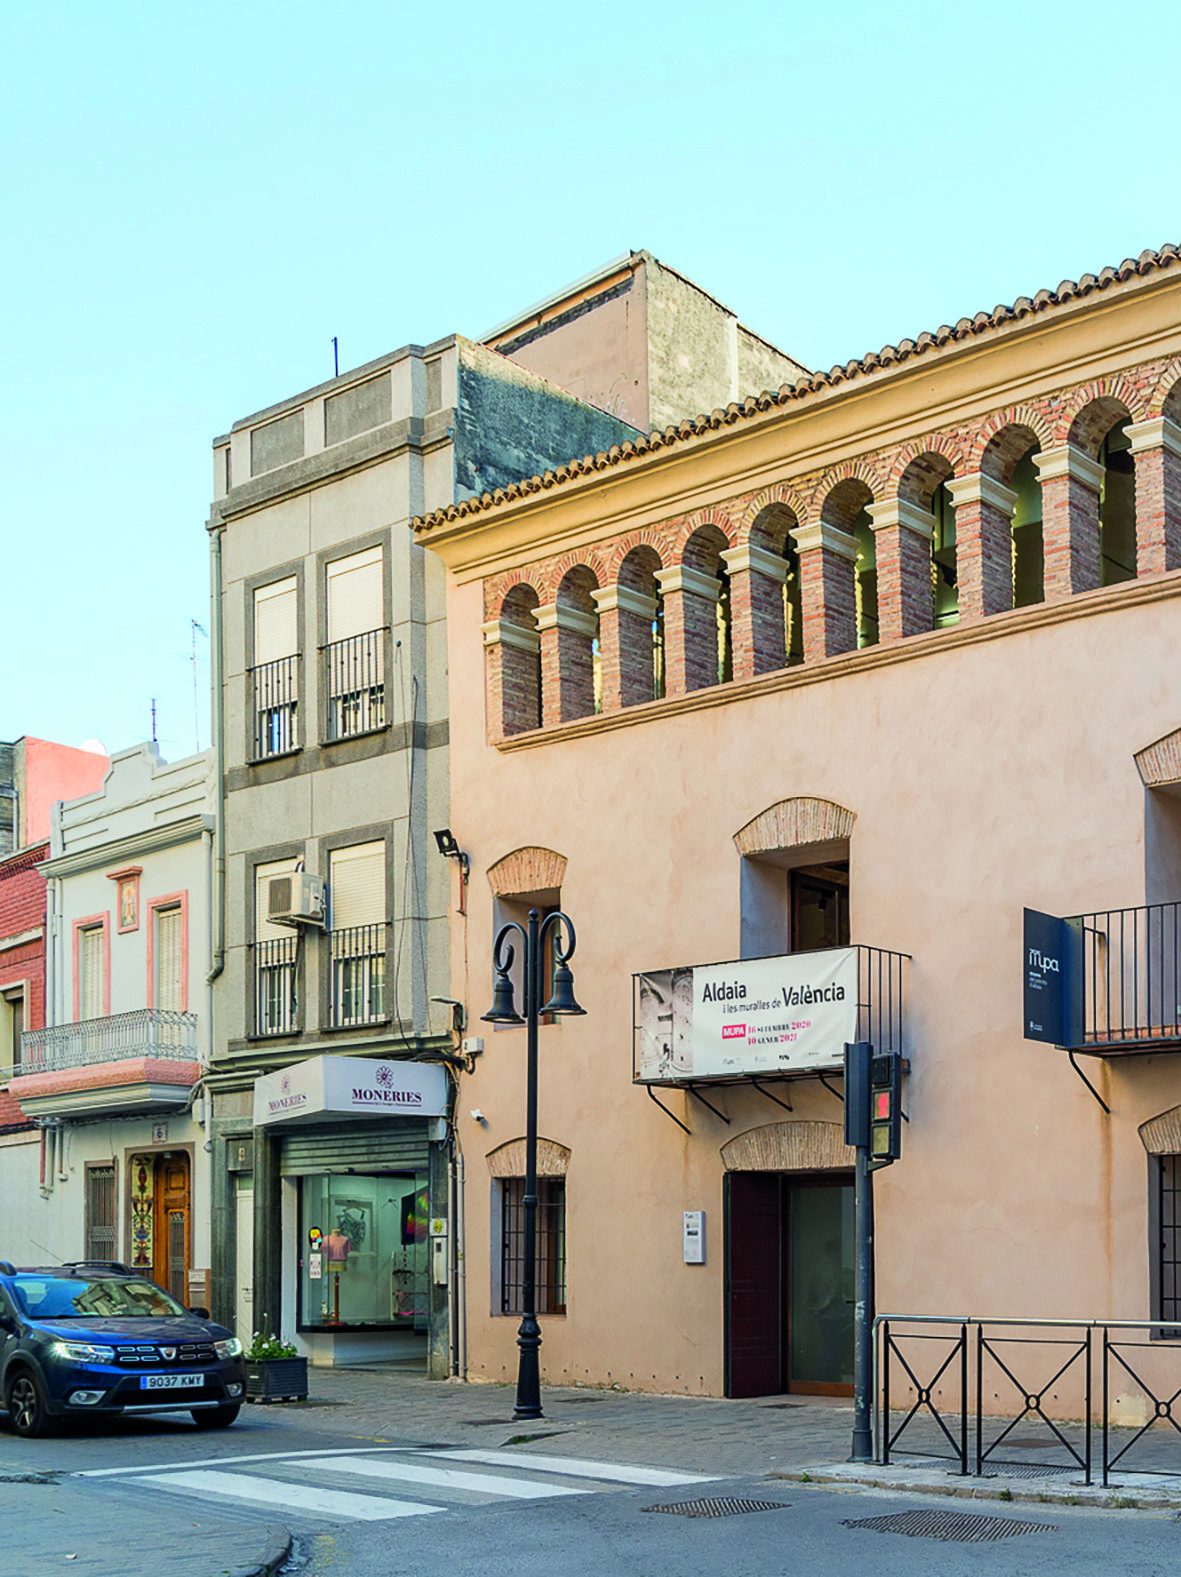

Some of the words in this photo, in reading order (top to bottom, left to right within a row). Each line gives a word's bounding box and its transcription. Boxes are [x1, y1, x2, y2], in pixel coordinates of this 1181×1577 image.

[702, 981, 747, 1002] Aldaia
[727, 1003, 738, 1014] les
[739, 1000, 770, 1012] muralles
[771, 998, 782, 1009] de
[782, 982, 845, 1007] València
[723, 1025, 745, 1037] MUPA
[791, 1020, 811, 1031] 2020
[748, 1037, 757, 1045] 10
[779, 1033, 797, 1043] 2021
[352, 1088, 422, 1103] MONERIES
[149, 1376, 178, 1387] 9037
[181, 1375, 202, 1386] KMY
